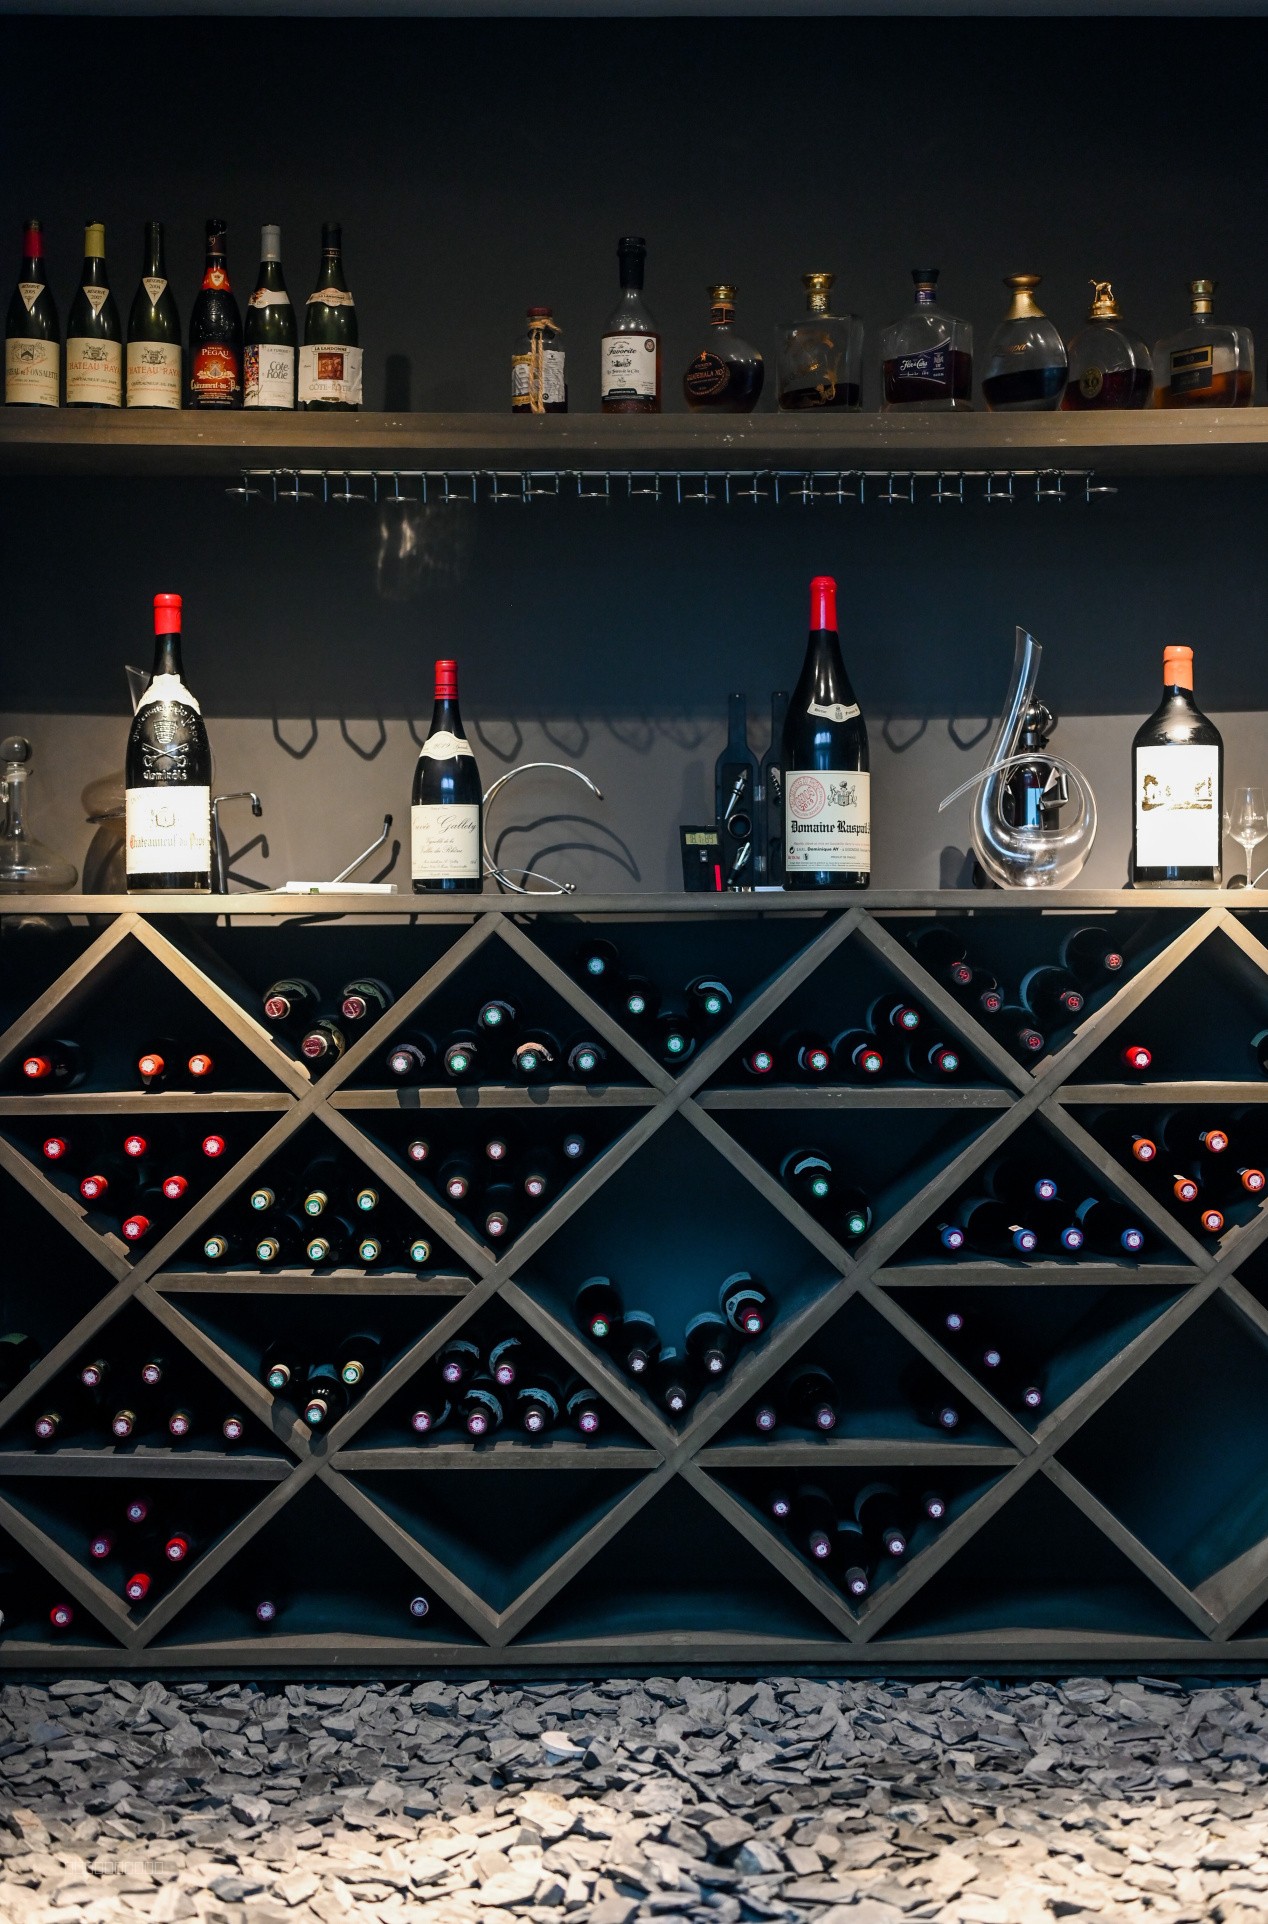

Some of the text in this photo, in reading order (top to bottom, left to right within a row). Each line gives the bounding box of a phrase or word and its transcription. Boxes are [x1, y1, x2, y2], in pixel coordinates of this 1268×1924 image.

[607, 347, 637, 356] Favorite
[68, 362, 99, 371] HATEAU
[791, 820, 835, 833] Domaine
